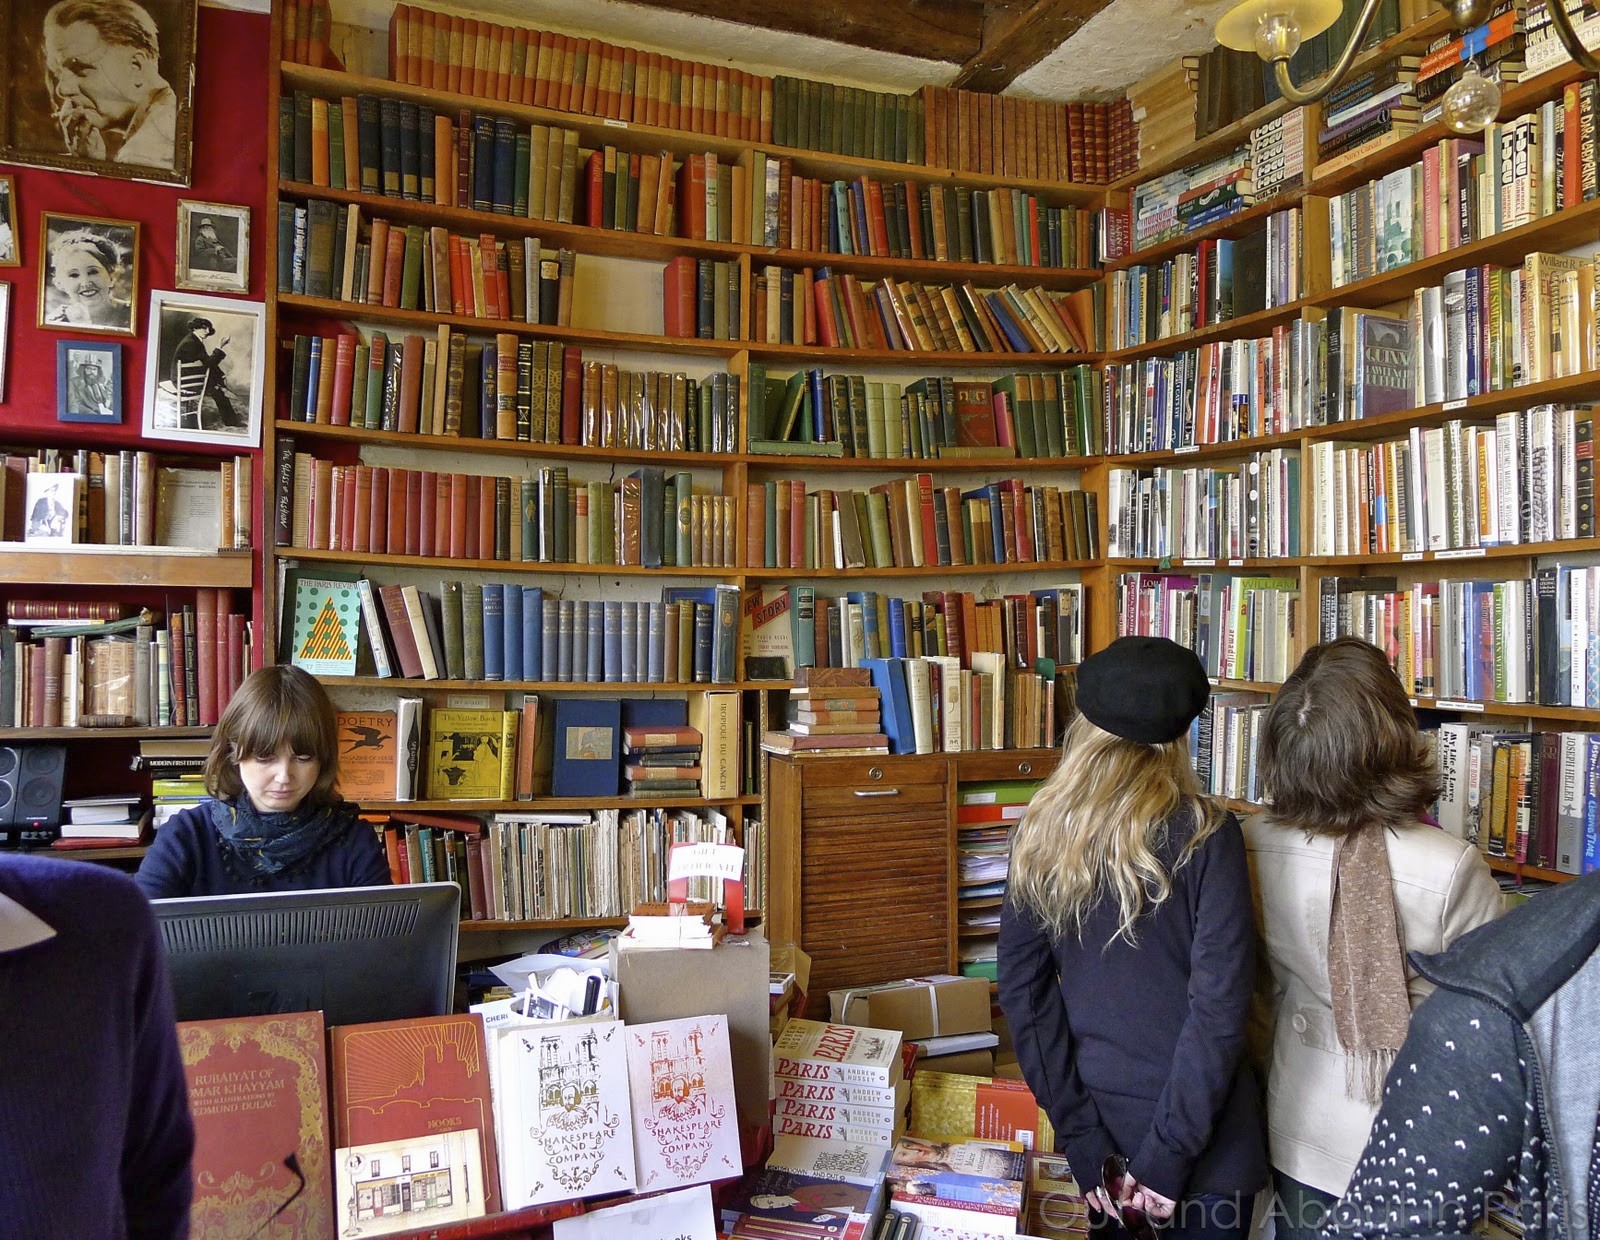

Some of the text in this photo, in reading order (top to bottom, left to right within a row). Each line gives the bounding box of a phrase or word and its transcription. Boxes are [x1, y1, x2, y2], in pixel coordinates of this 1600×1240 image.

[1438, 47, 1458, 58] Graham
[1436, 61, 1456, 73] Graham
[1581, 140, 1596, 191] LABYRINTH
[1351, 231, 1357, 239] OF
[1357, 188, 1368, 273] Lawrence Durrell
[1541, 257, 1568, 268] Willard
[1490, 273, 1499, 337] THE SAMURAI
[1527, 274, 1536, 371] The Garden of Eloquence
[282, 449, 292, 461] THE
[1479, 445, 1487, 465] Bits
[1504, 437, 1512, 468] SOMETIMES
[225, 464, 233, 492] EXILES
[280, 463, 292, 484] GLASS
[1480, 468, 1487, 478] of
[280, 496, 290, 529] FASHION
[314, 581, 331, 589] PARIS
[1243, 581, 1296, 590] WILLIAM
[756, 597, 787, 624] STORY
[1227, 629, 1235, 667] armadillo
[443, 714, 496, 722] The Yellow Book
[1442, 731, 1449, 743] by
[1449, 732, 1457, 747] My
[1469, 731, 1480, 740] My
[720, 744, 727, 755] DU
[1449, 748, 1457, 766] Life
[719, 758, 727, 791] CANCER
[1564, 737, 1576, 801] JOSEPH HELLER
[1449, 777, 1457, 803] Loves
[1586, 738, 1600, 858] Joseph Heller CLOSING TIME
[812, 1025, 856, 1062] PARIS
[259, 1068, 275, 1079] OF
[775, 1058, 830, 1080] PARIS
[847, 1068, 876, 1076] ANDREW
[847, 1075, 875, 1083] HUSSEY
[780, 1080, 836, 1101] PARIS
[852, 1088, 881, 1096] ANDREW
[193, 1099, 277, 1116] EDMUND DULAC
[782, 1098, 836, 1121] PARIS
[852, 1110, 881, 1118] ANDREW
[427, 1116, 463, 1129] NOOKS
[852, 1116, 880, 1124] HUSSEY
[651, 1119, 722, 1137] SHAKESPEARE
[778, 1117, 833, 1140] PARIS
[850, 1129, 879, 1137] ANDREW
[537, 1128, 616, 1146] SHAKESPEARE
[674, 1133, 696, 1141] AND
[563, 1142, 586, 1151] AND
[662, 1142, 712, 1153] COMPANY
[549, 1152, 603, 1164] COMPANY
